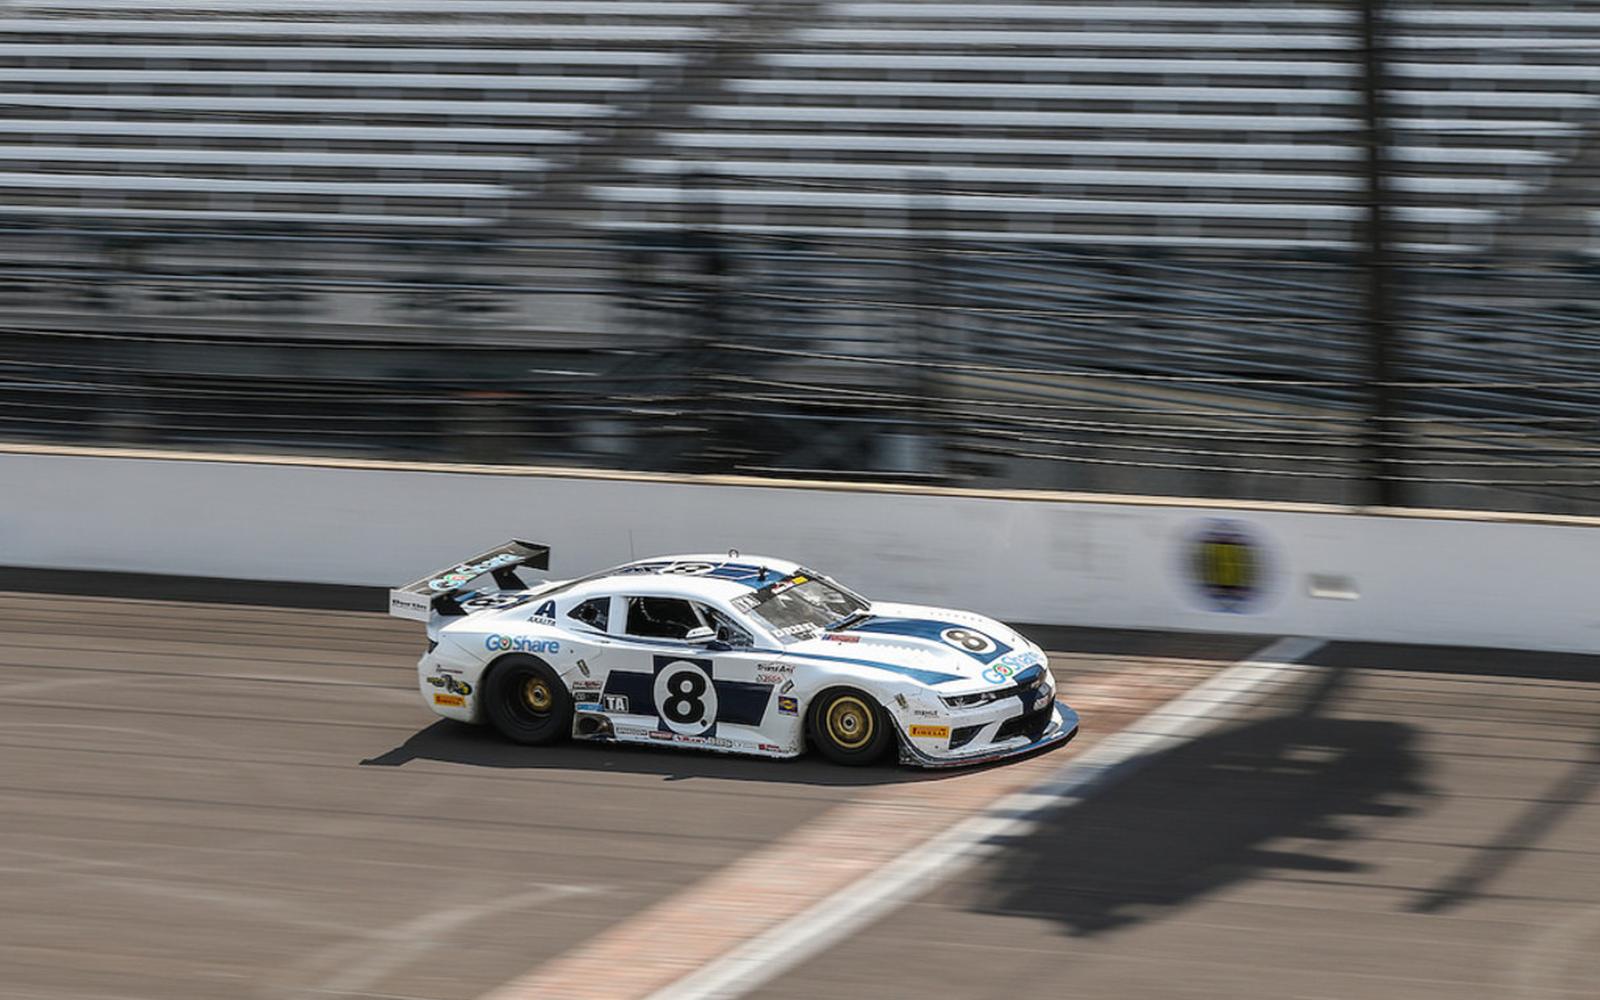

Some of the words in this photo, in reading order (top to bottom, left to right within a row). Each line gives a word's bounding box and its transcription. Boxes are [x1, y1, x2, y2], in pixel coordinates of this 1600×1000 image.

[946, 629, 988, 651] 8
[606, 697, 625, 711] TA
[662, 671, 707, 724] 8
